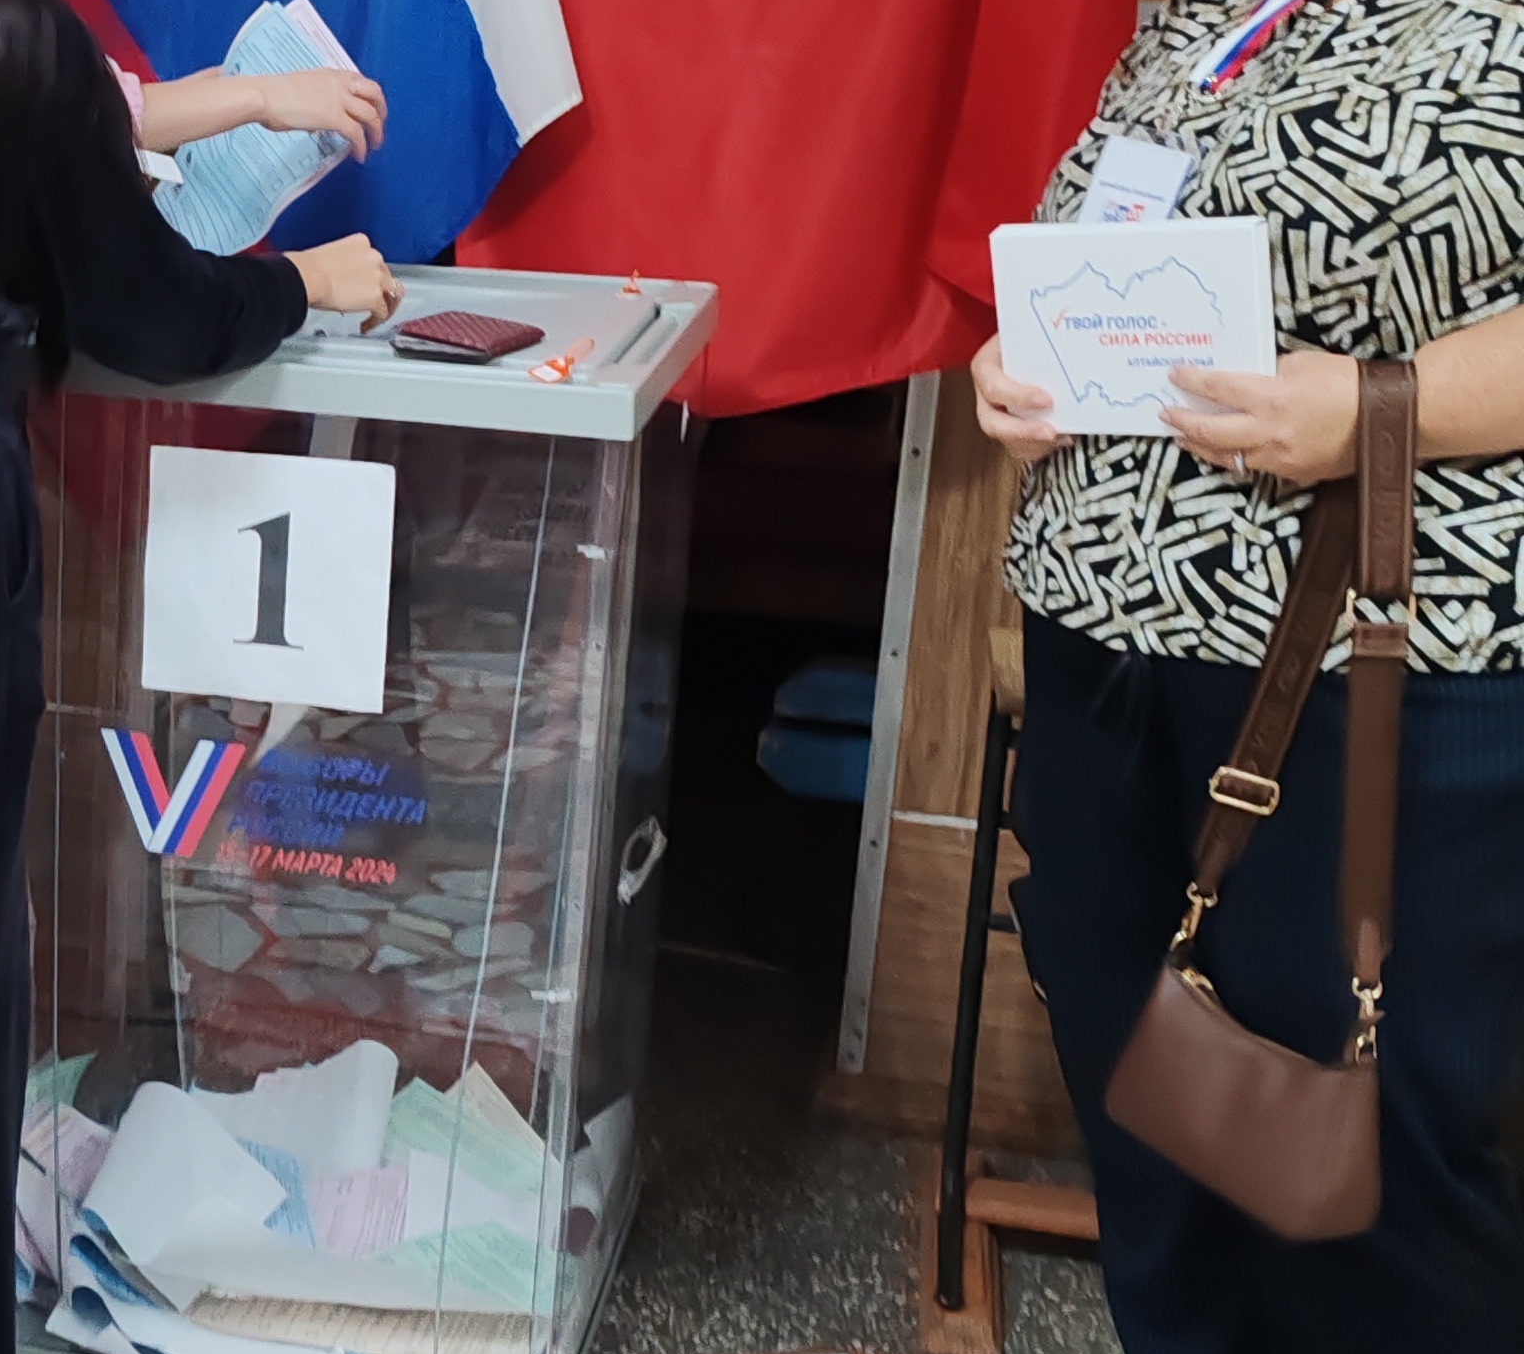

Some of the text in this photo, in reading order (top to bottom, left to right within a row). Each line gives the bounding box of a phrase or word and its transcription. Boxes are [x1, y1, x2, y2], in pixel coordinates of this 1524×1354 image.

[1065, 315, 1103, 330] ТВОЙ
[1107, 316, 1157, 330] ГОЛОС
[1099, 332, 1213, 346] СИЛА РОССИИ!
[233, 511, 305, 651] 1
[272, 848, 343, 878] МАРТА
